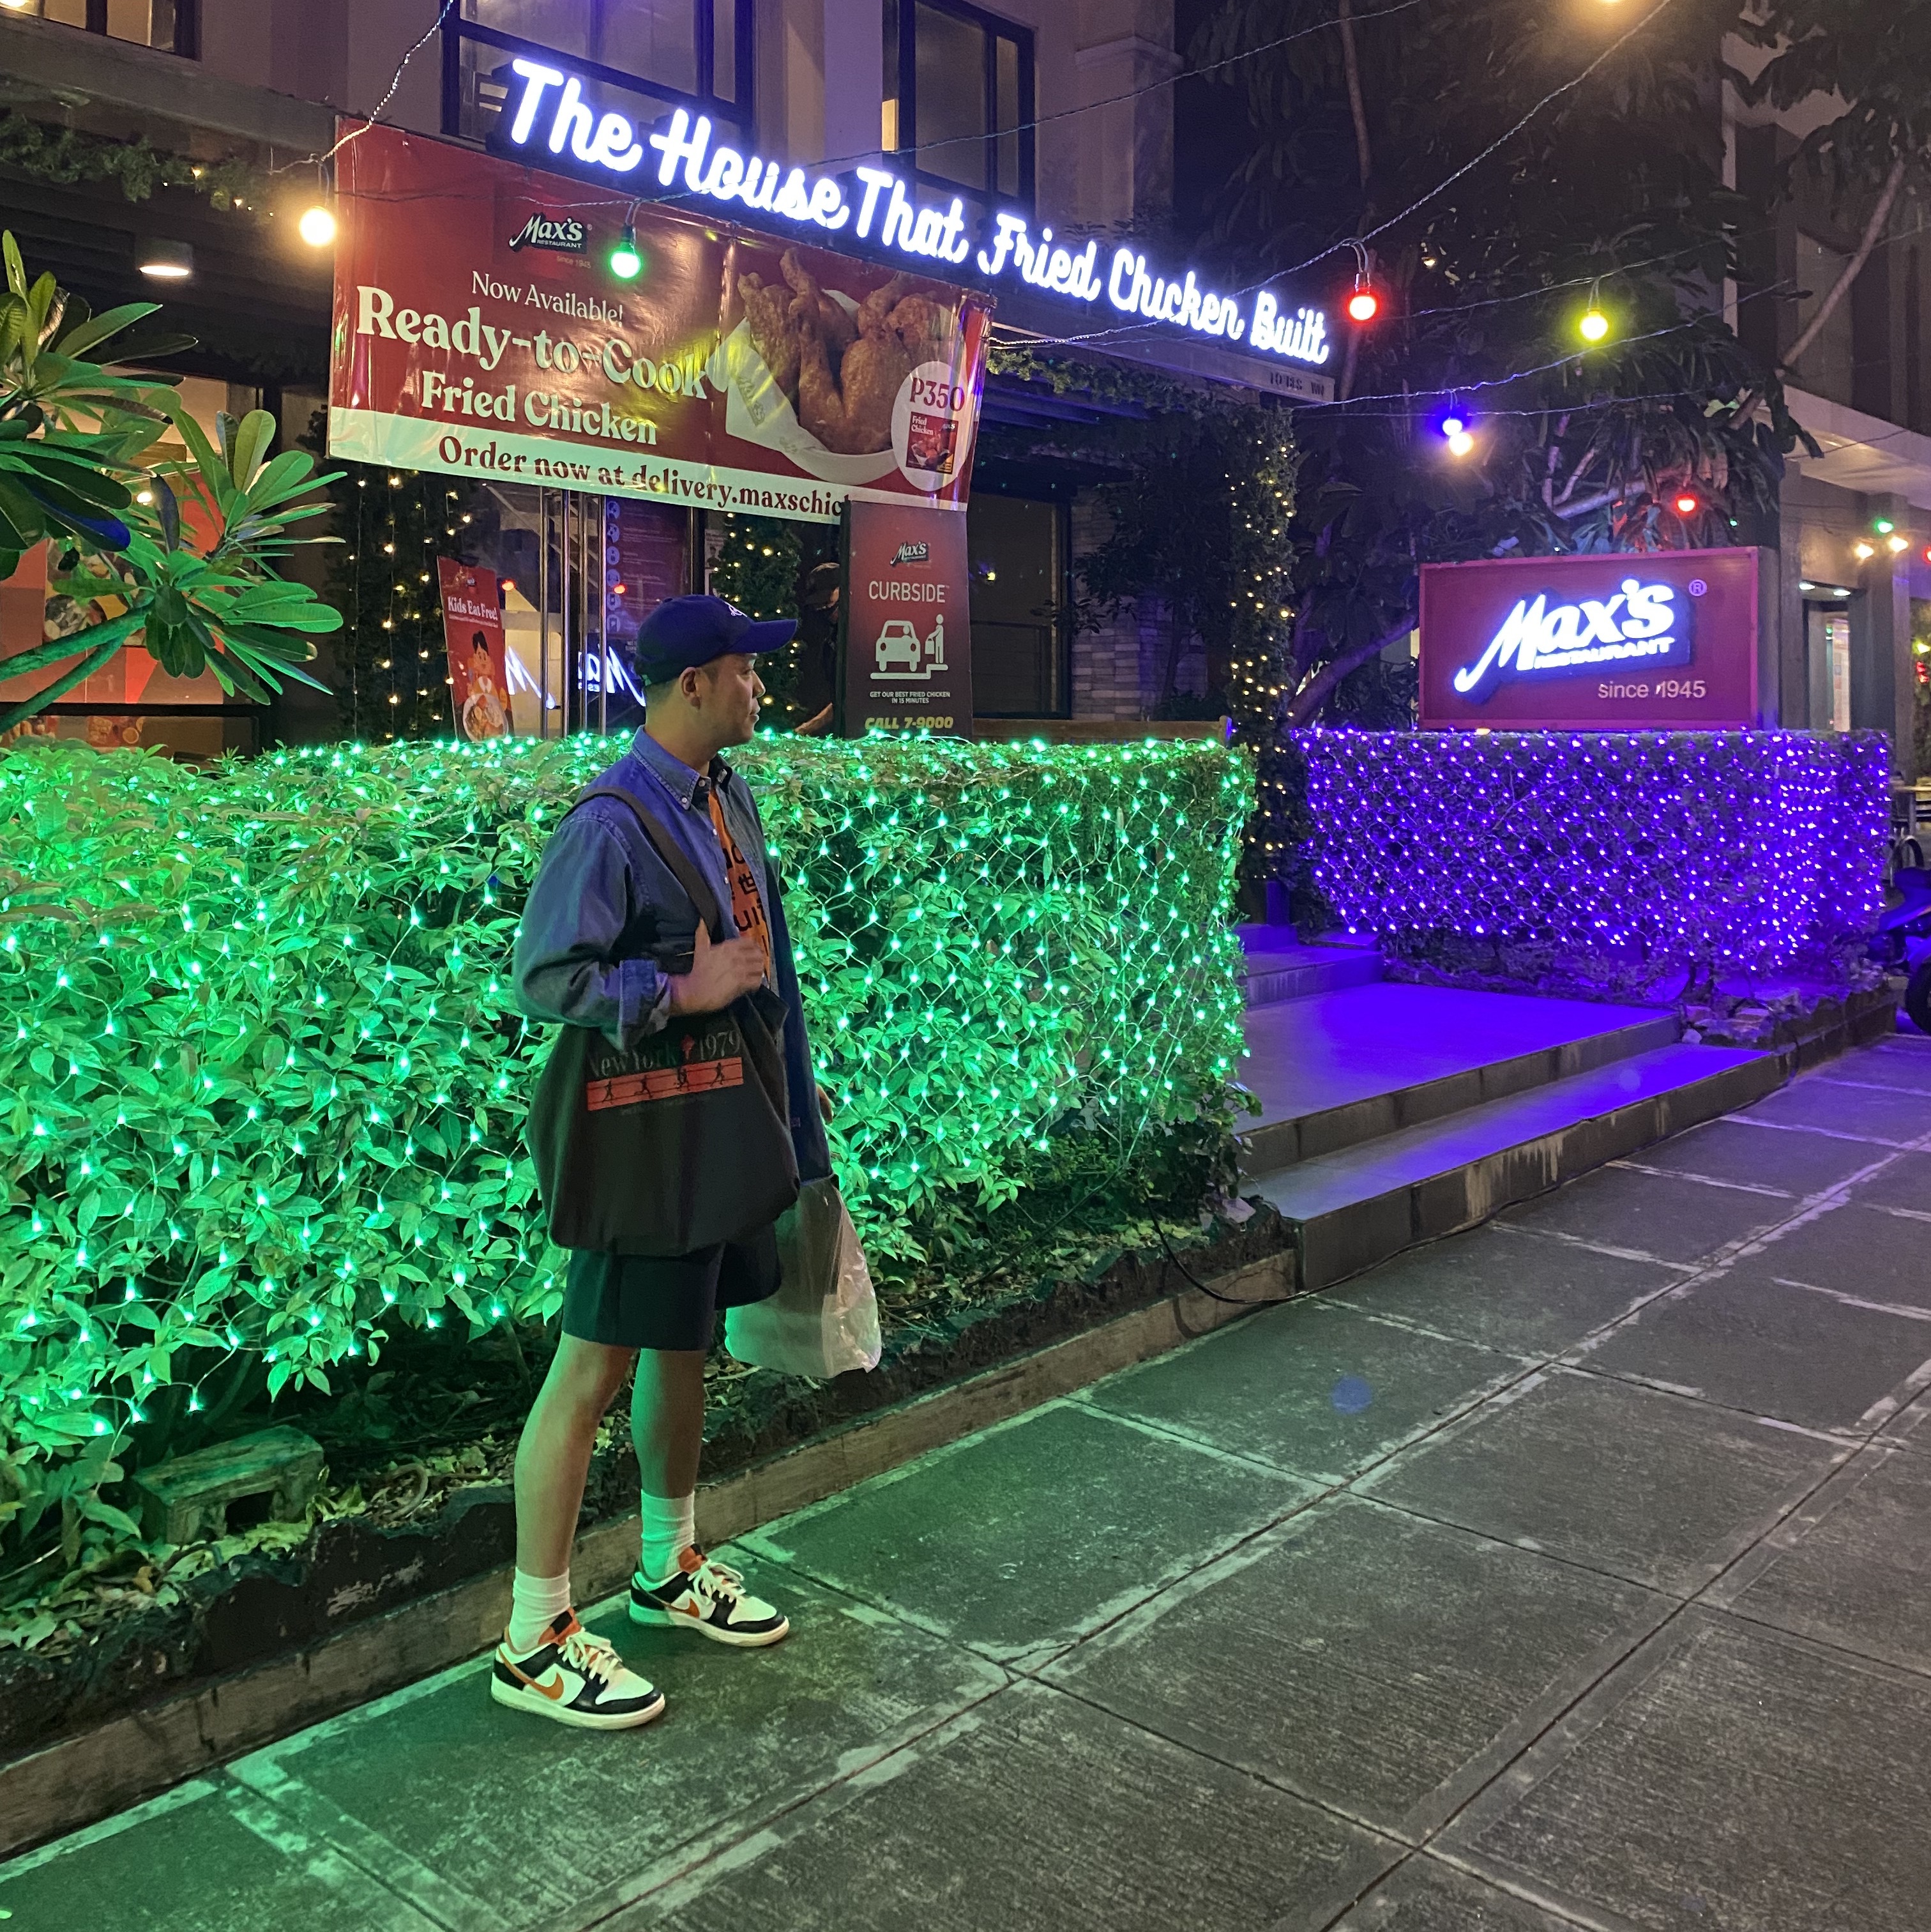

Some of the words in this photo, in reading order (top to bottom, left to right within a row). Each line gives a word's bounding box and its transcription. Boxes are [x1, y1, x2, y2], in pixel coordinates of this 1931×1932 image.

[510, 58, 642, 172] The
[649, 107, 850, 229] House
[856, 167, 969, 262] That
[978, 213, 1102, 301] Fried
[1109, 248, 1245, 340] Chicken
[1250, 291, 1329, 364] Built
[509, 215, 582, 247] Max's
[536, 240, 582, 248] RESTAURANT
[471, 271, 522, 302] Now
[524, 284, 623, 327] Available!
[356, 285, 708, 400] Ready-to-Cook
[421, 370, 516, 423] Fried
[524, 391, 658, 446] Chicken
[439, 435, 533, 473] Order
[534, 454, 591, 480] now
[598, 465, 626, 487] at
[631, 464, 849, 517] delivery.maxschic
[890, 542, 927, 565] Max's
[448, 597, 467, 613] Kids
[467, 600, 481, 616] Eat
[868, 581, 946, 603] CURBSIDE
[1453, 579, 1674, 693] Max's
[1598, 680, 1649, 699] since
[1660, 680, 1707, 699] 1945
[865, 717, 899, 730] CALL
[904, 716, 954, 729] 7-9000
